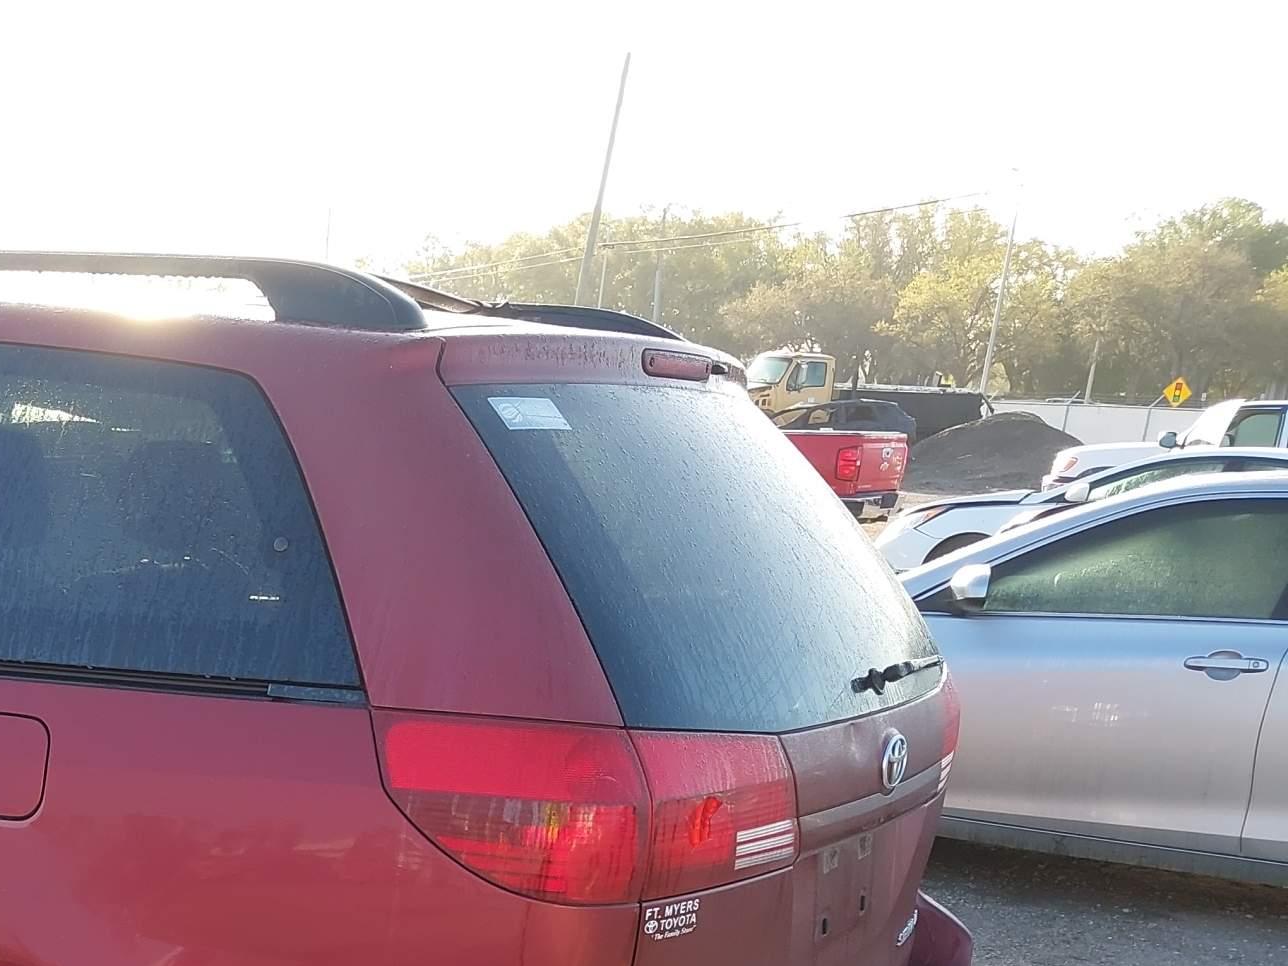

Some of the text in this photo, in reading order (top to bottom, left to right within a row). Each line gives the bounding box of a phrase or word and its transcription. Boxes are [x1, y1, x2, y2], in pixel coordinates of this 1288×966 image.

[645, 898, 700, 920] FT. MYERS
[660, 912, 697, 931] TOYOTA
